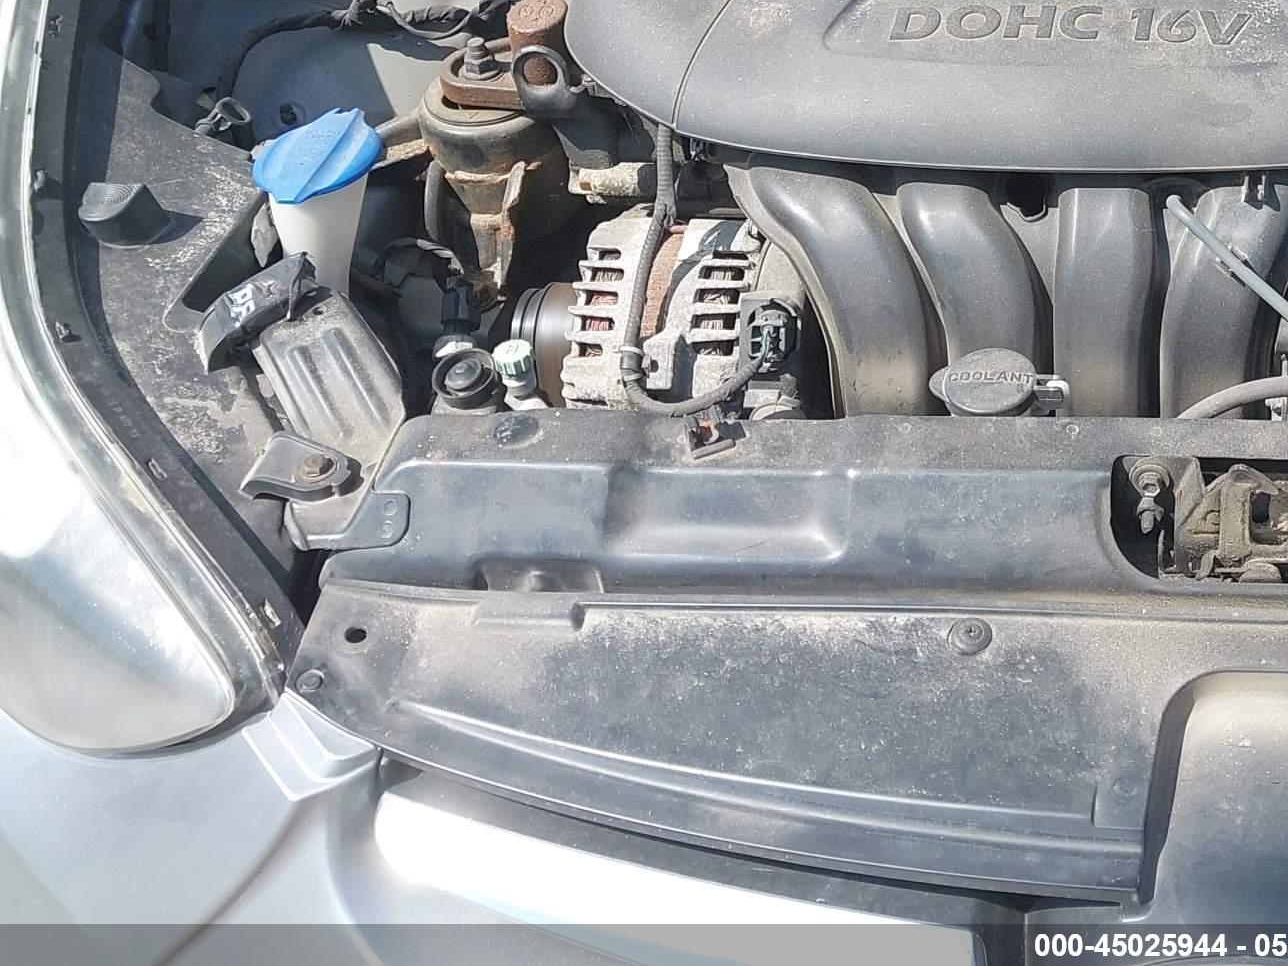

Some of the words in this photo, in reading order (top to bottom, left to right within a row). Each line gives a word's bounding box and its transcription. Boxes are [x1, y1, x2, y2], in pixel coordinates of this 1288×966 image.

[889, 5, 1103, 40] DOHC
[1130, 8, 1253, 46] 16V
[948, 371, 1034, 385] COOLANT
